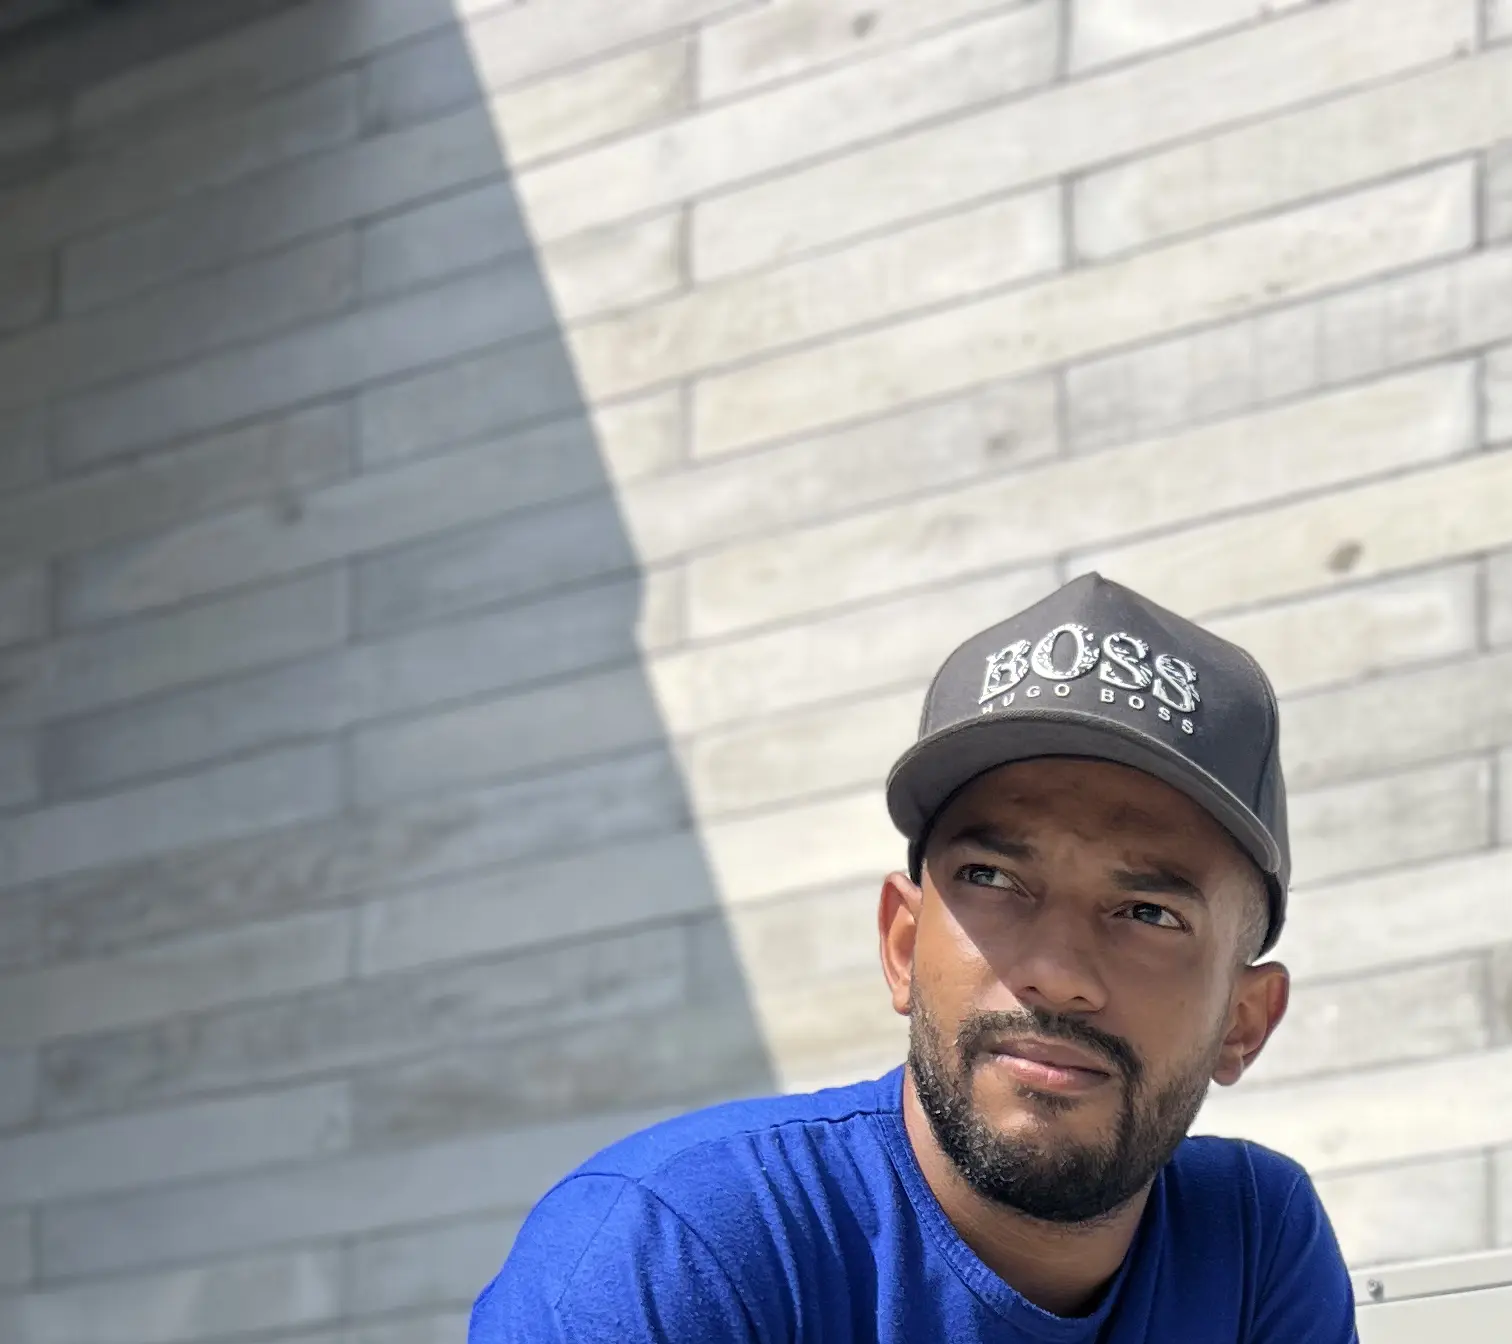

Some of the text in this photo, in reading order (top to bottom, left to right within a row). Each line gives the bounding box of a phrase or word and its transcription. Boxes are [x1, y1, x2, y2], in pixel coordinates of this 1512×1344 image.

[978, 623, 1201, 713] BOSS
[981, 683, 1194, 735] HUGO BOSS
